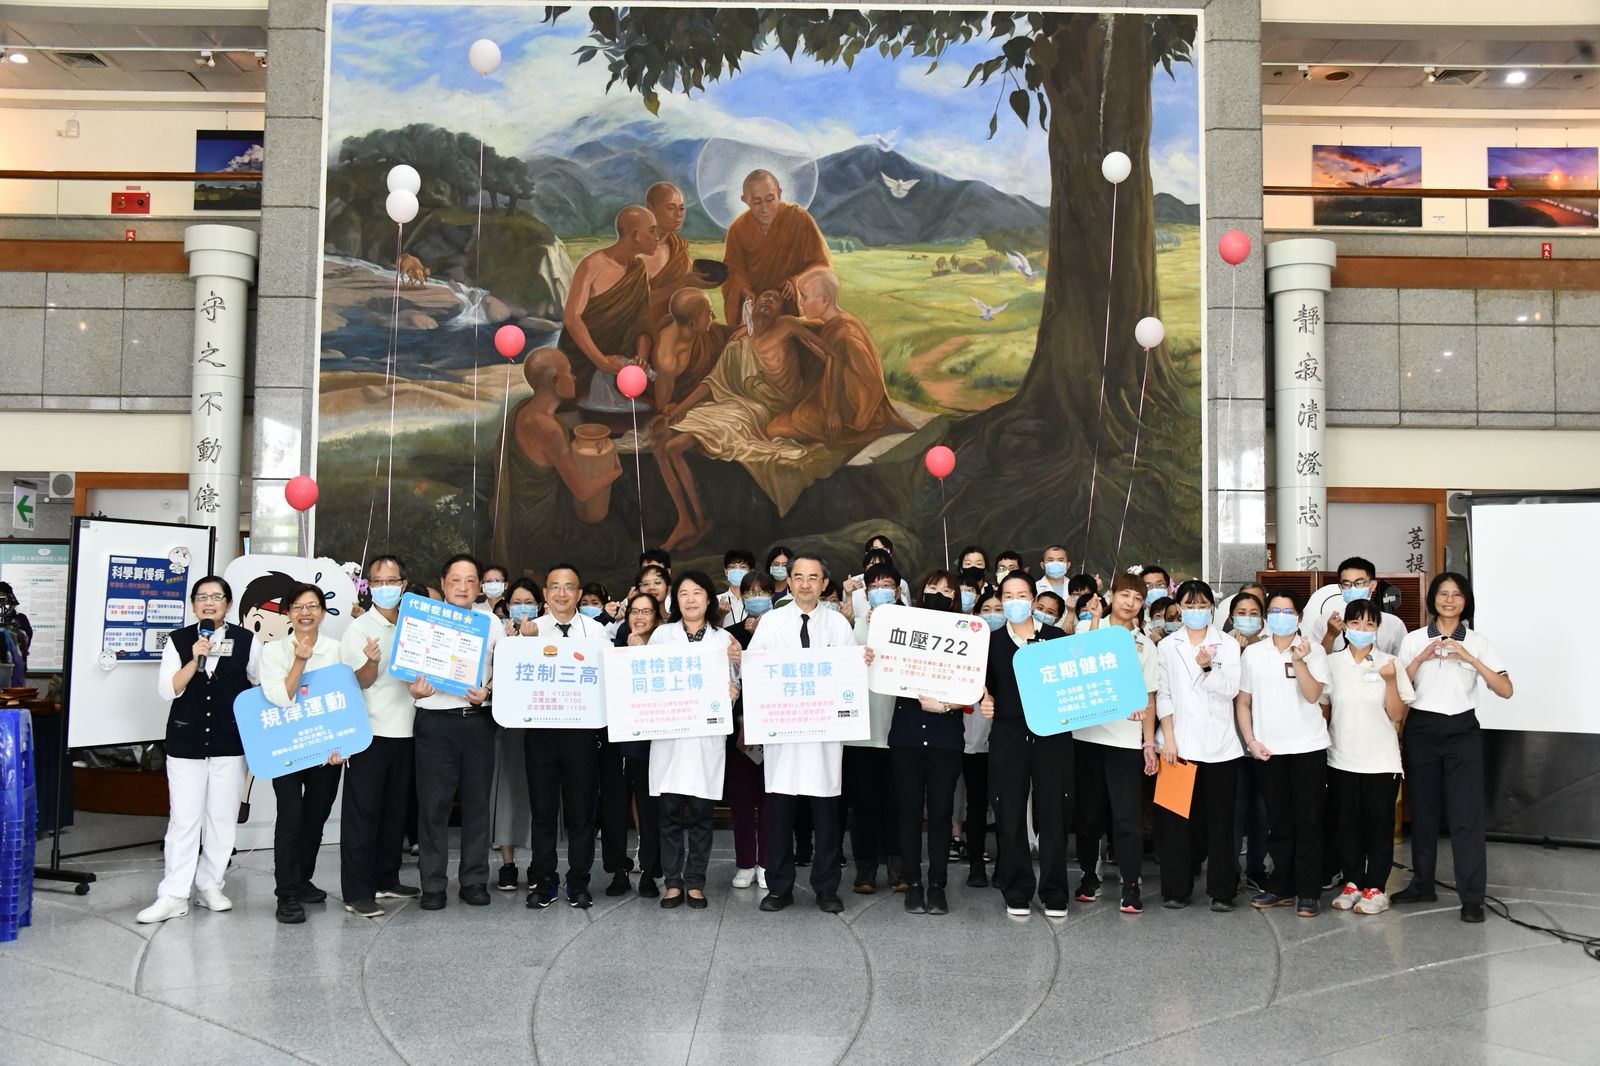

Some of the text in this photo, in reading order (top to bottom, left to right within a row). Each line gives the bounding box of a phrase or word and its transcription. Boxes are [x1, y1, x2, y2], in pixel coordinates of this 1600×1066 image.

[1406, 526, 1426, 573] 菩提
[111, 565, 166, 582] 科學算慢病
[409, 598, 463, 622] 代謝症候群
[889, 627, 969, 656] 血壓722
[515, 662, 599, 685] 控制三高
[631, 655, 702, 675] 健檢資料
[763, 661, 833, 680] 下載健康
[1039, 651, 1119, 684] 定期健檢
[632, 673, 704, 694] 同意上傳
[783, 680, 816, 697] 存摺
[259, 690, 347, 729] 規律運動
